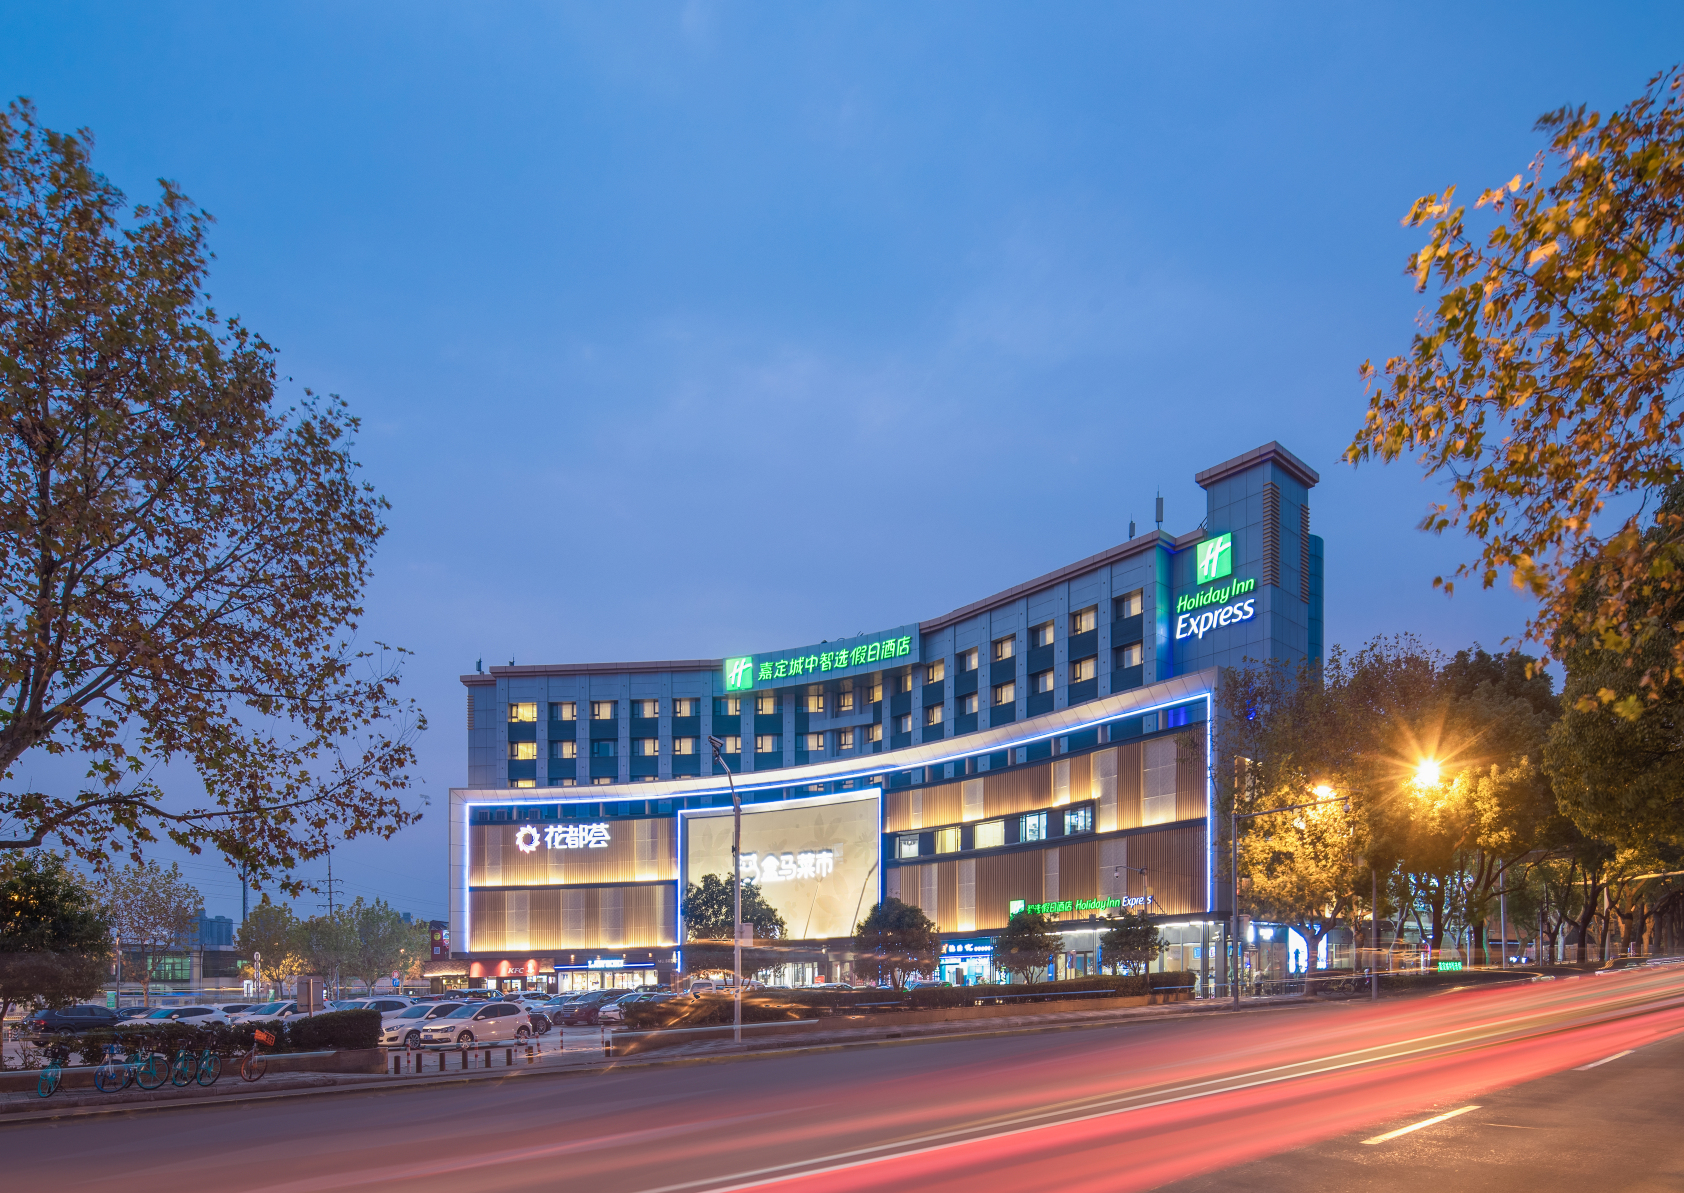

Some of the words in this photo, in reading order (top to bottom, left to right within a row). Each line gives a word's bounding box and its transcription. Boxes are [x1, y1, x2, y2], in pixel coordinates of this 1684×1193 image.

[1176, 586, 1231, 614] Holiday
[1231, 578, 1255, 597] Inn
[1175, 598, 1256, 640] Express
[757, 635, 912, 682] 嘉定城中智选假日酒店
[543, 822, 611, 850] 花都荟
[760, 849, 833, 882] 盒马菜市
[1075, 897, 1107, 911] Holiday
[1106, 896, 1121, 908] Inn
[1122, 894, 1153, 909] Expres
